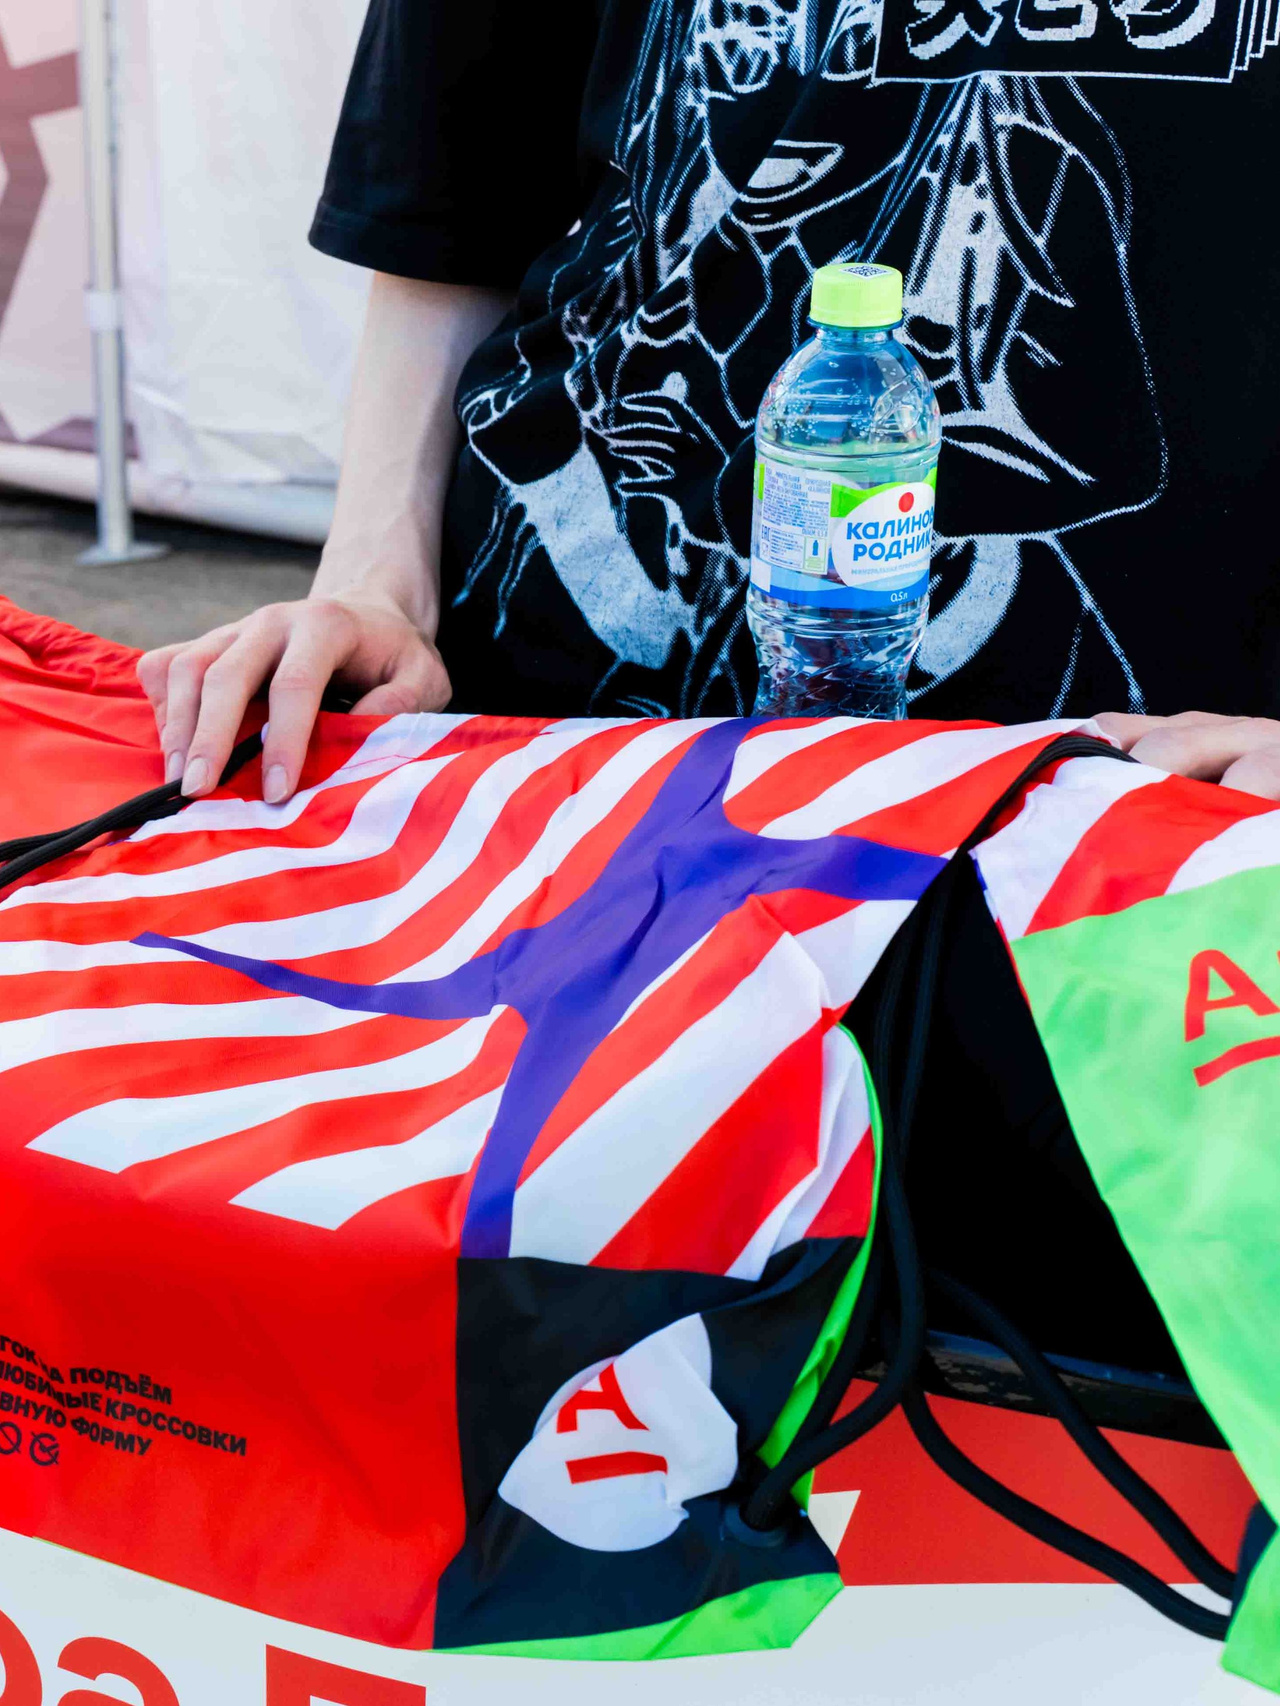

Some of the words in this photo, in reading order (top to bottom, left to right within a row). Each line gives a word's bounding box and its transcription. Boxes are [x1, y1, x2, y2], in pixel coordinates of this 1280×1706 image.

[853, 529, 932, 562] РОДНИК
[70, 1365, 173, 1405] ПОДЪЁМ
[70, 1416, 153, 1456] ФОРМУ
[105, 1397, 248, 1457] КРОССОВКИ
